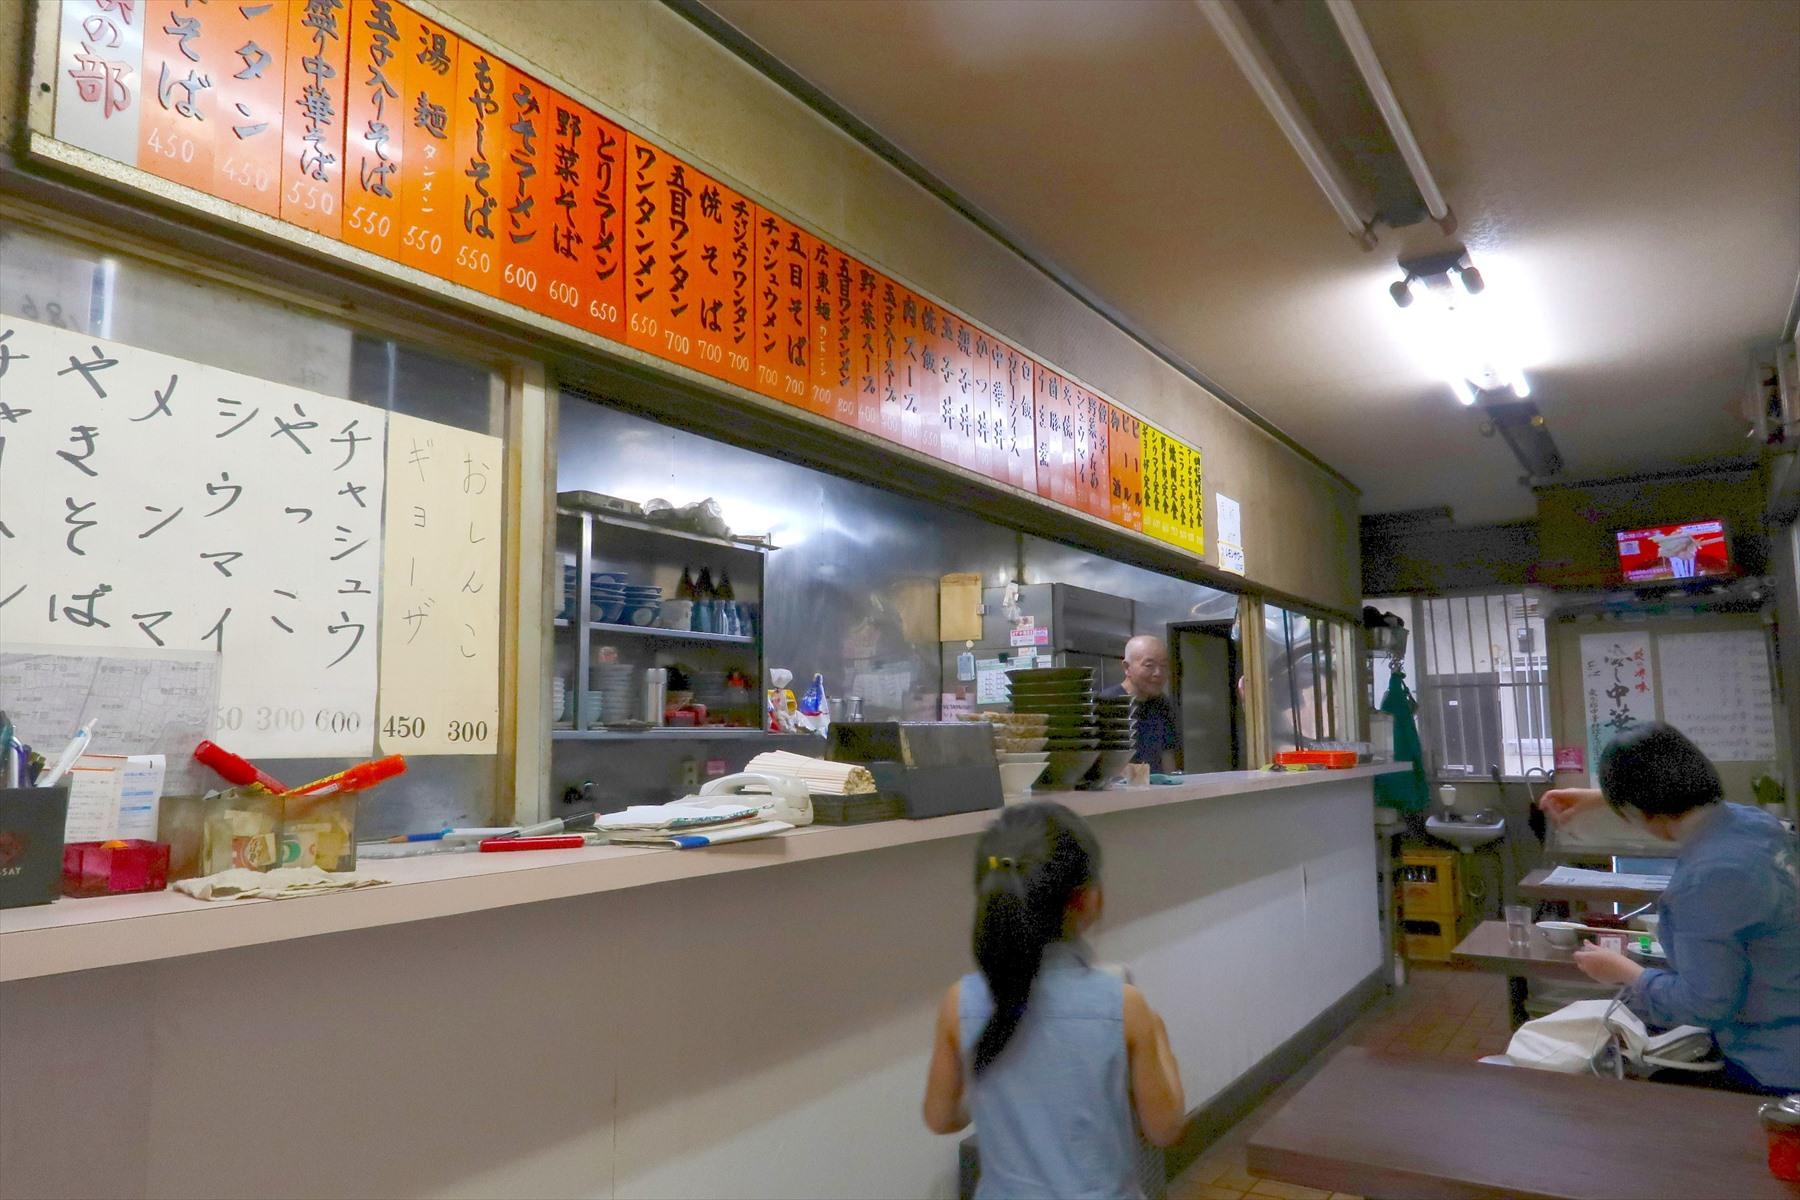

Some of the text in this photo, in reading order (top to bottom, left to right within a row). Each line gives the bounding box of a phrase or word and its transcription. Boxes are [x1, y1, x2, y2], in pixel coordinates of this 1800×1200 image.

[147, 128, 194, 163] 450
[464, 55, 499, 240] もやしそば
[222, 158, 270, 193] 450
[552, 106, 583, 262] 野菜そば
[287, 182, 335, 215] 550
[592, 127, 617, 281] とりラーメン
[348, 205, 391, 238] 550
[634, 144, 656, 303] ワンタンメン
[403, 226, 442, 255] 550
[666, 164, 692, 318] 五目ワンタン
[456, 246, 491, 273] 550
[699, 184, 723, 333] 焼そば
[504, 263, 537, 292] 600
[548, 280, 579, 308] 600
[786, 231, 808, 367] 五目そば
[589, 299, 617, 323] 650
[630, 312, 658, 337] 650
[664, 330, 690, 355] 700
[698, 339, 722, 364] 700
[728, 351, 750, 372] 700
[758, 365, 778, 386] 700
[785, 375, 805, 396] 700
[812, 386, 831, 405] 700
[837, 398, 854, 416] 800
[48, 344, 120, 629] やきそば
[128, 373, 184, 647] メンマ
[200, 396, 260, 654] シウマイ
[270, 402, 319, 635] やっこ
[327, 419, 372, 669] チャシュウ
[460, 452, 491, 660] おしんこ
[256, 706, 305, 733] 300
[315, 708, 362, 735] 600
[382, 715, 427, 740] 450
[446, 719, 489, 743] 300
